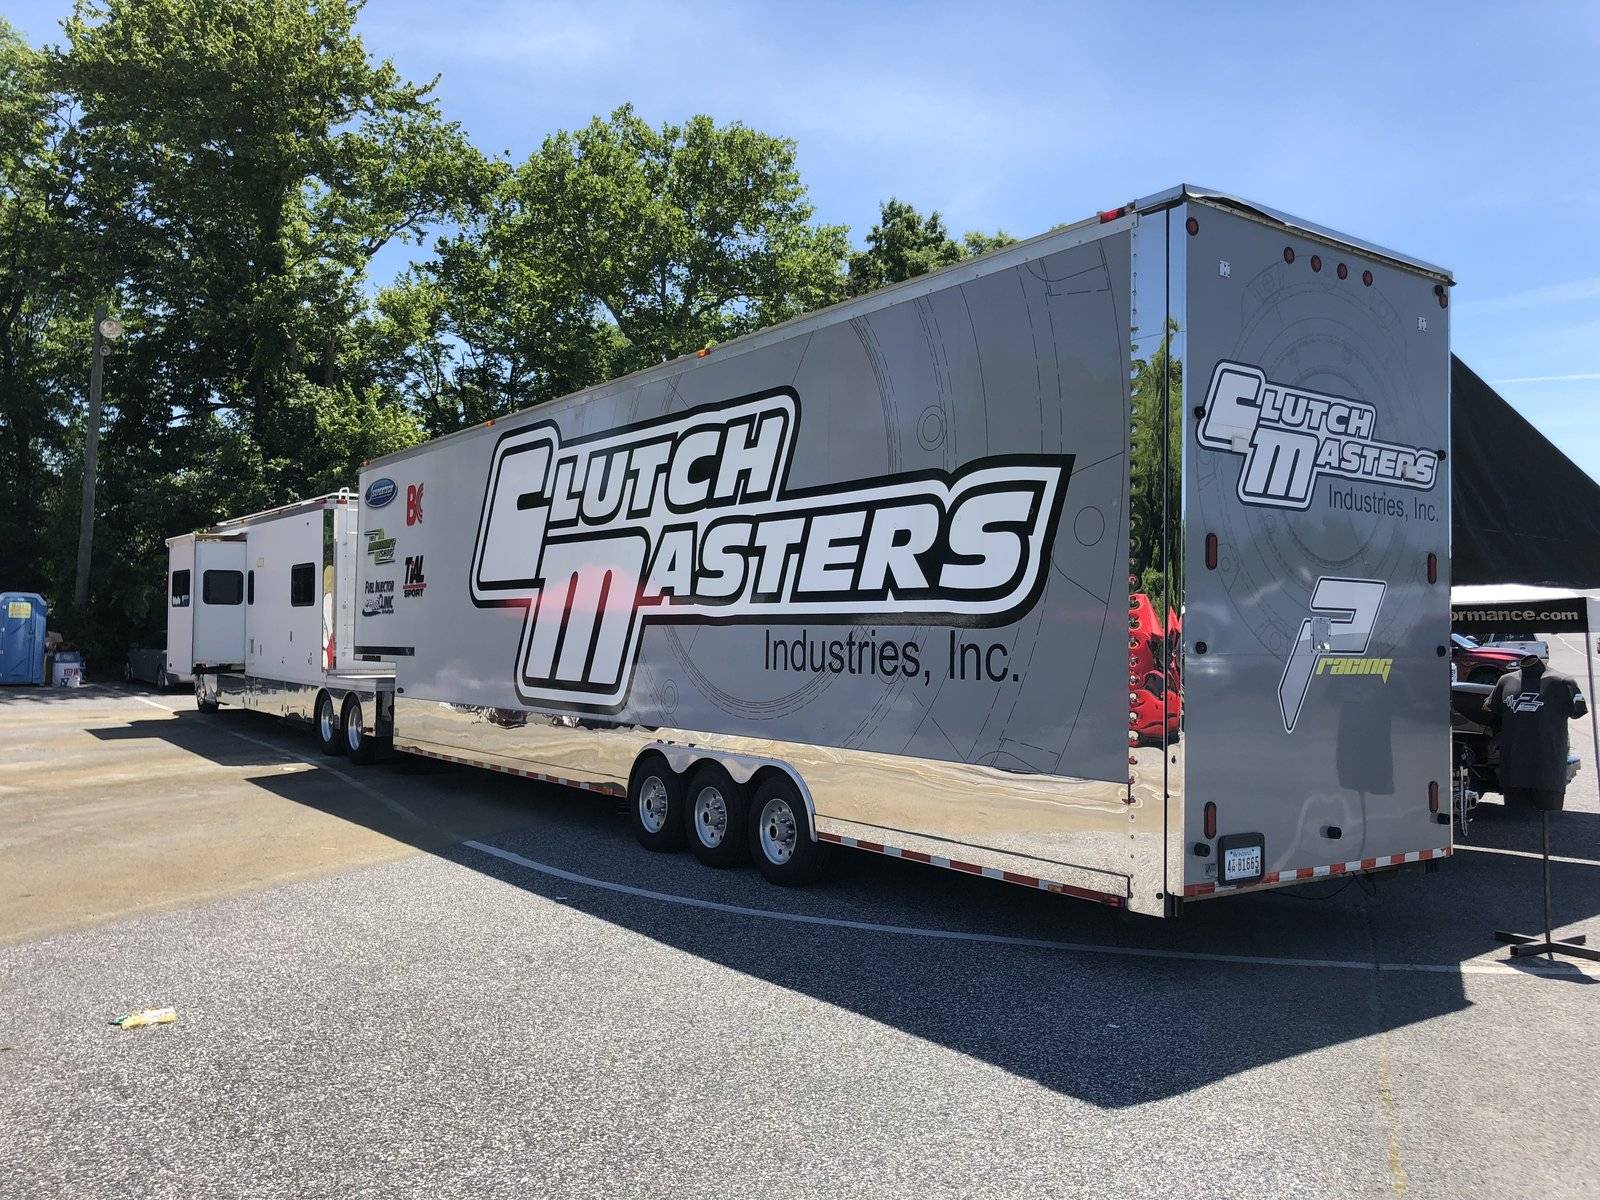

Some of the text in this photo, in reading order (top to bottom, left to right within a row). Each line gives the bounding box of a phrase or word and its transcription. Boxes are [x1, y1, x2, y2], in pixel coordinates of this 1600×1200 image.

[1202, 368, 1374, 442] CLUTCH
[1242, 424, 1438, 500] MASTERS
[477, 406, 787, 586] CLUTCH
[1328, 484, 1440, 522] Industries, Inc.
[403, 588, 424, 598] SPORT
[520, 486, 1040, 690] MASTERS
[763, 628, 1020, 687] Industries, Inc.
[1315, 657, 1393, 684] racing
